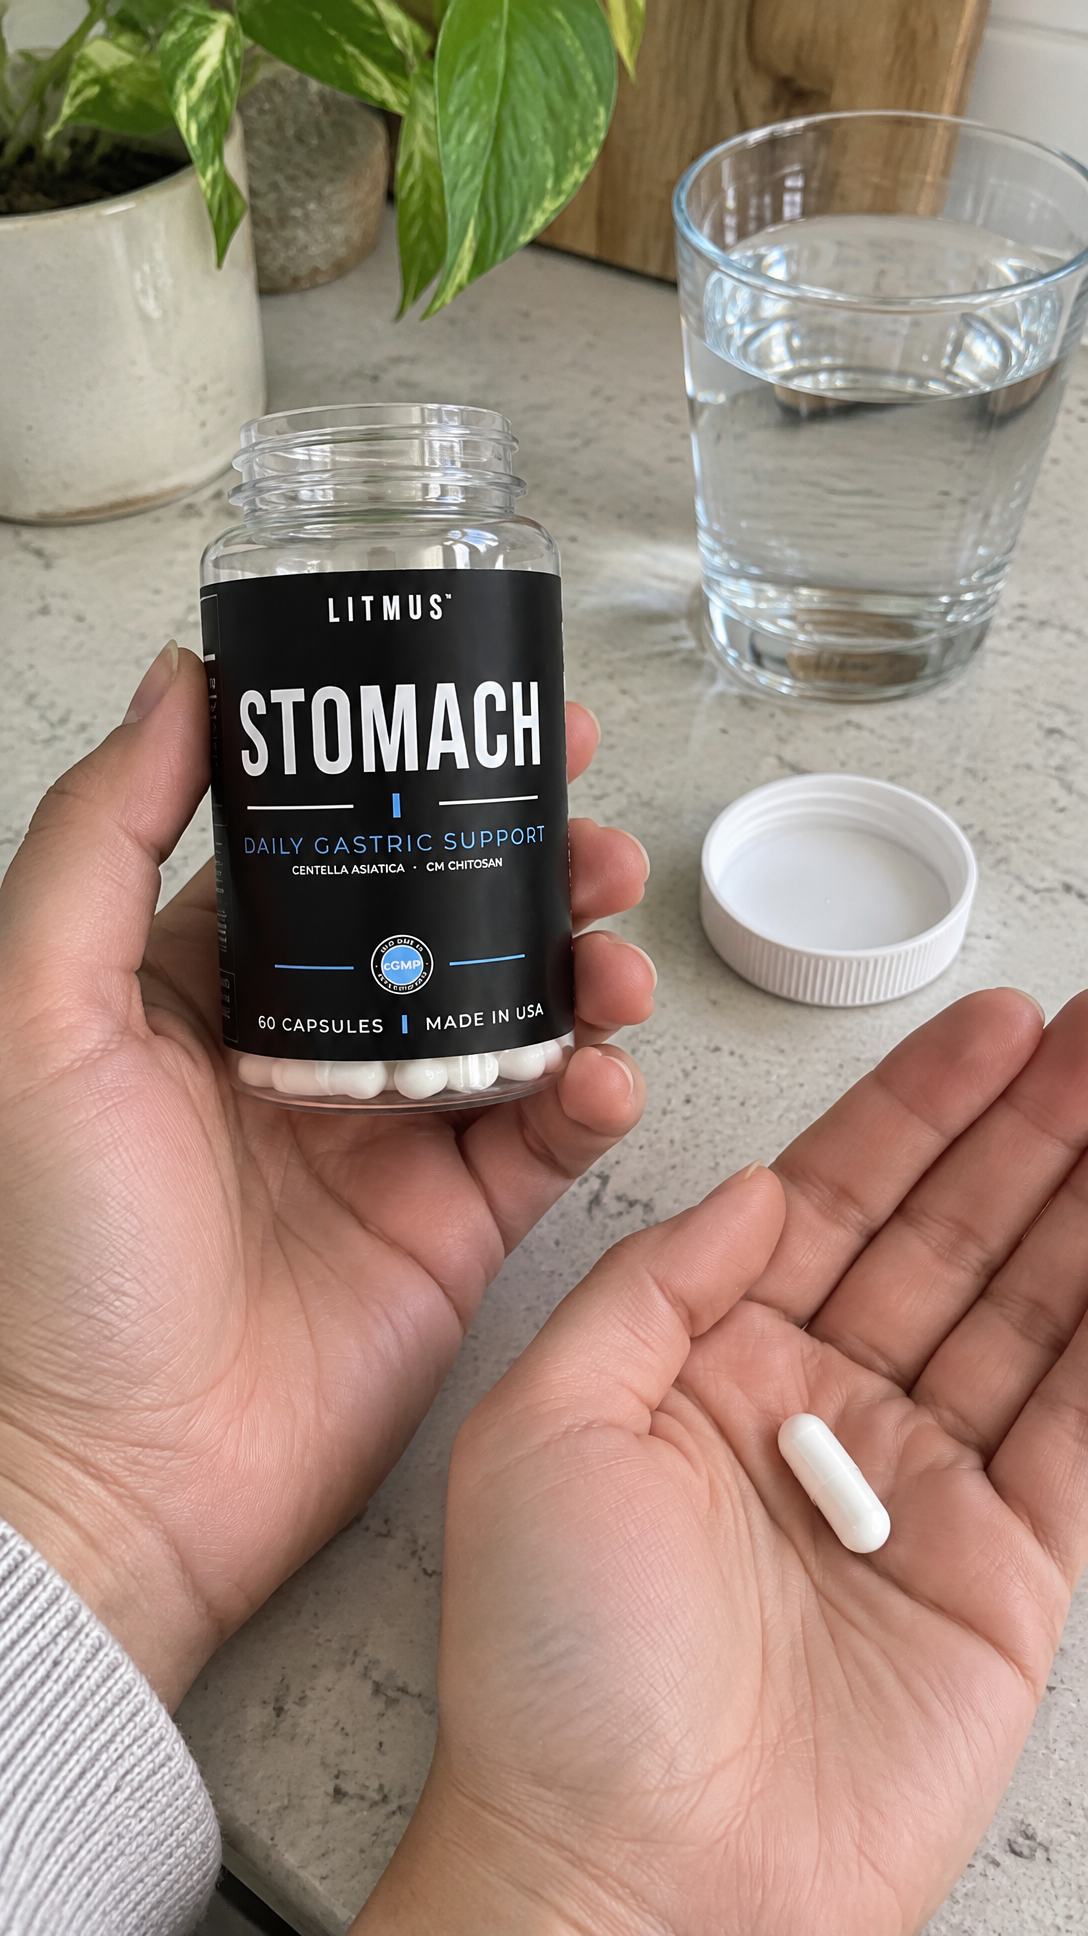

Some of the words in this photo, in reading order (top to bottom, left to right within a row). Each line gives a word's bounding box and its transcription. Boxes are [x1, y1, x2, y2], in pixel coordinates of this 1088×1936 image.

[239, 680, 542, 777] STOMACH
[244, 837, 303, 855] DAILY
[314, 833, 433, 855] GASTRIC
[444, 825, 545, 850] SUPPORT
[292, 864, 349, 876] CENTELLA
[351, 863, 406, 875] ASIATICA
[426, 861, 445, 872] CM
[447, 857, 503, 871] CHITOSAN
[383, 959, 422, 971] cGMP
[258, 1015, 276, 1030] 60
[281, 1017, 384, 1034] CAPSULES
[426, 1011, 485, 1031] MADE
[492, 1008, 510, 1025] IN
[516, 1002, 545, 1019] USA
